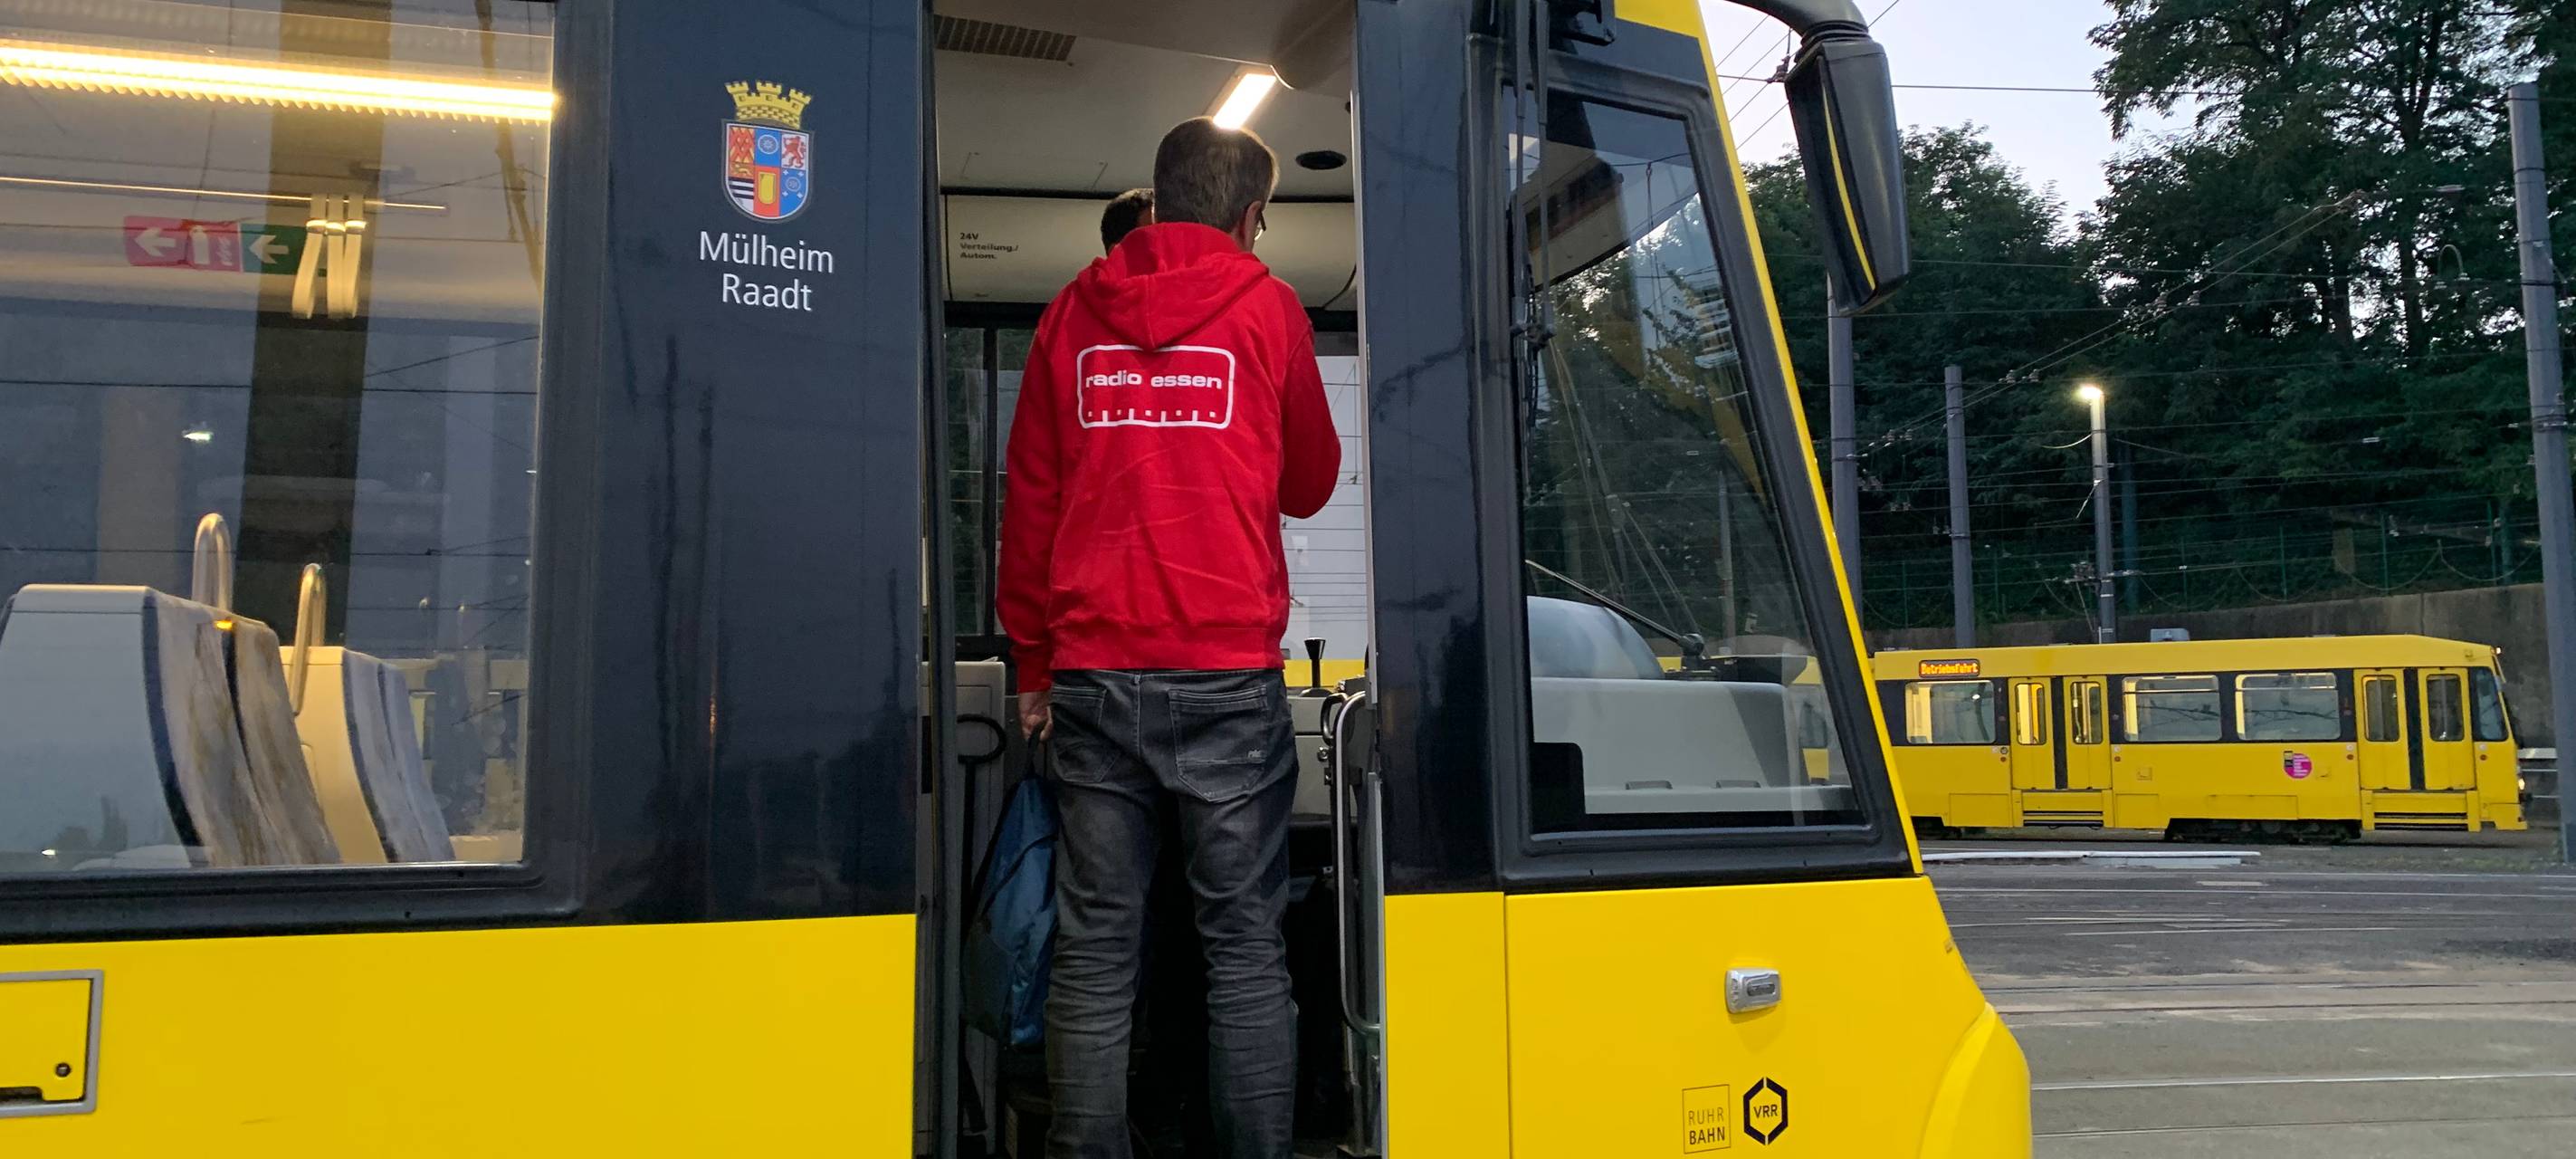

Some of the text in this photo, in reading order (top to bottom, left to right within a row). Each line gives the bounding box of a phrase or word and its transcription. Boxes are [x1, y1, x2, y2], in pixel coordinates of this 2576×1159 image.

[959, 232, 979, 240] 24V
[700, 231, 834, 273] Mülheim
[722, 273, 813, 311] Raadt
[1085, 369, 1222, 389] radio essen
[1688, 1106, 1724, 1125] RUHR
[1752, 1104, 1778, 1118] VRR
[1689, 1126, 1725, 1145] BAHN
